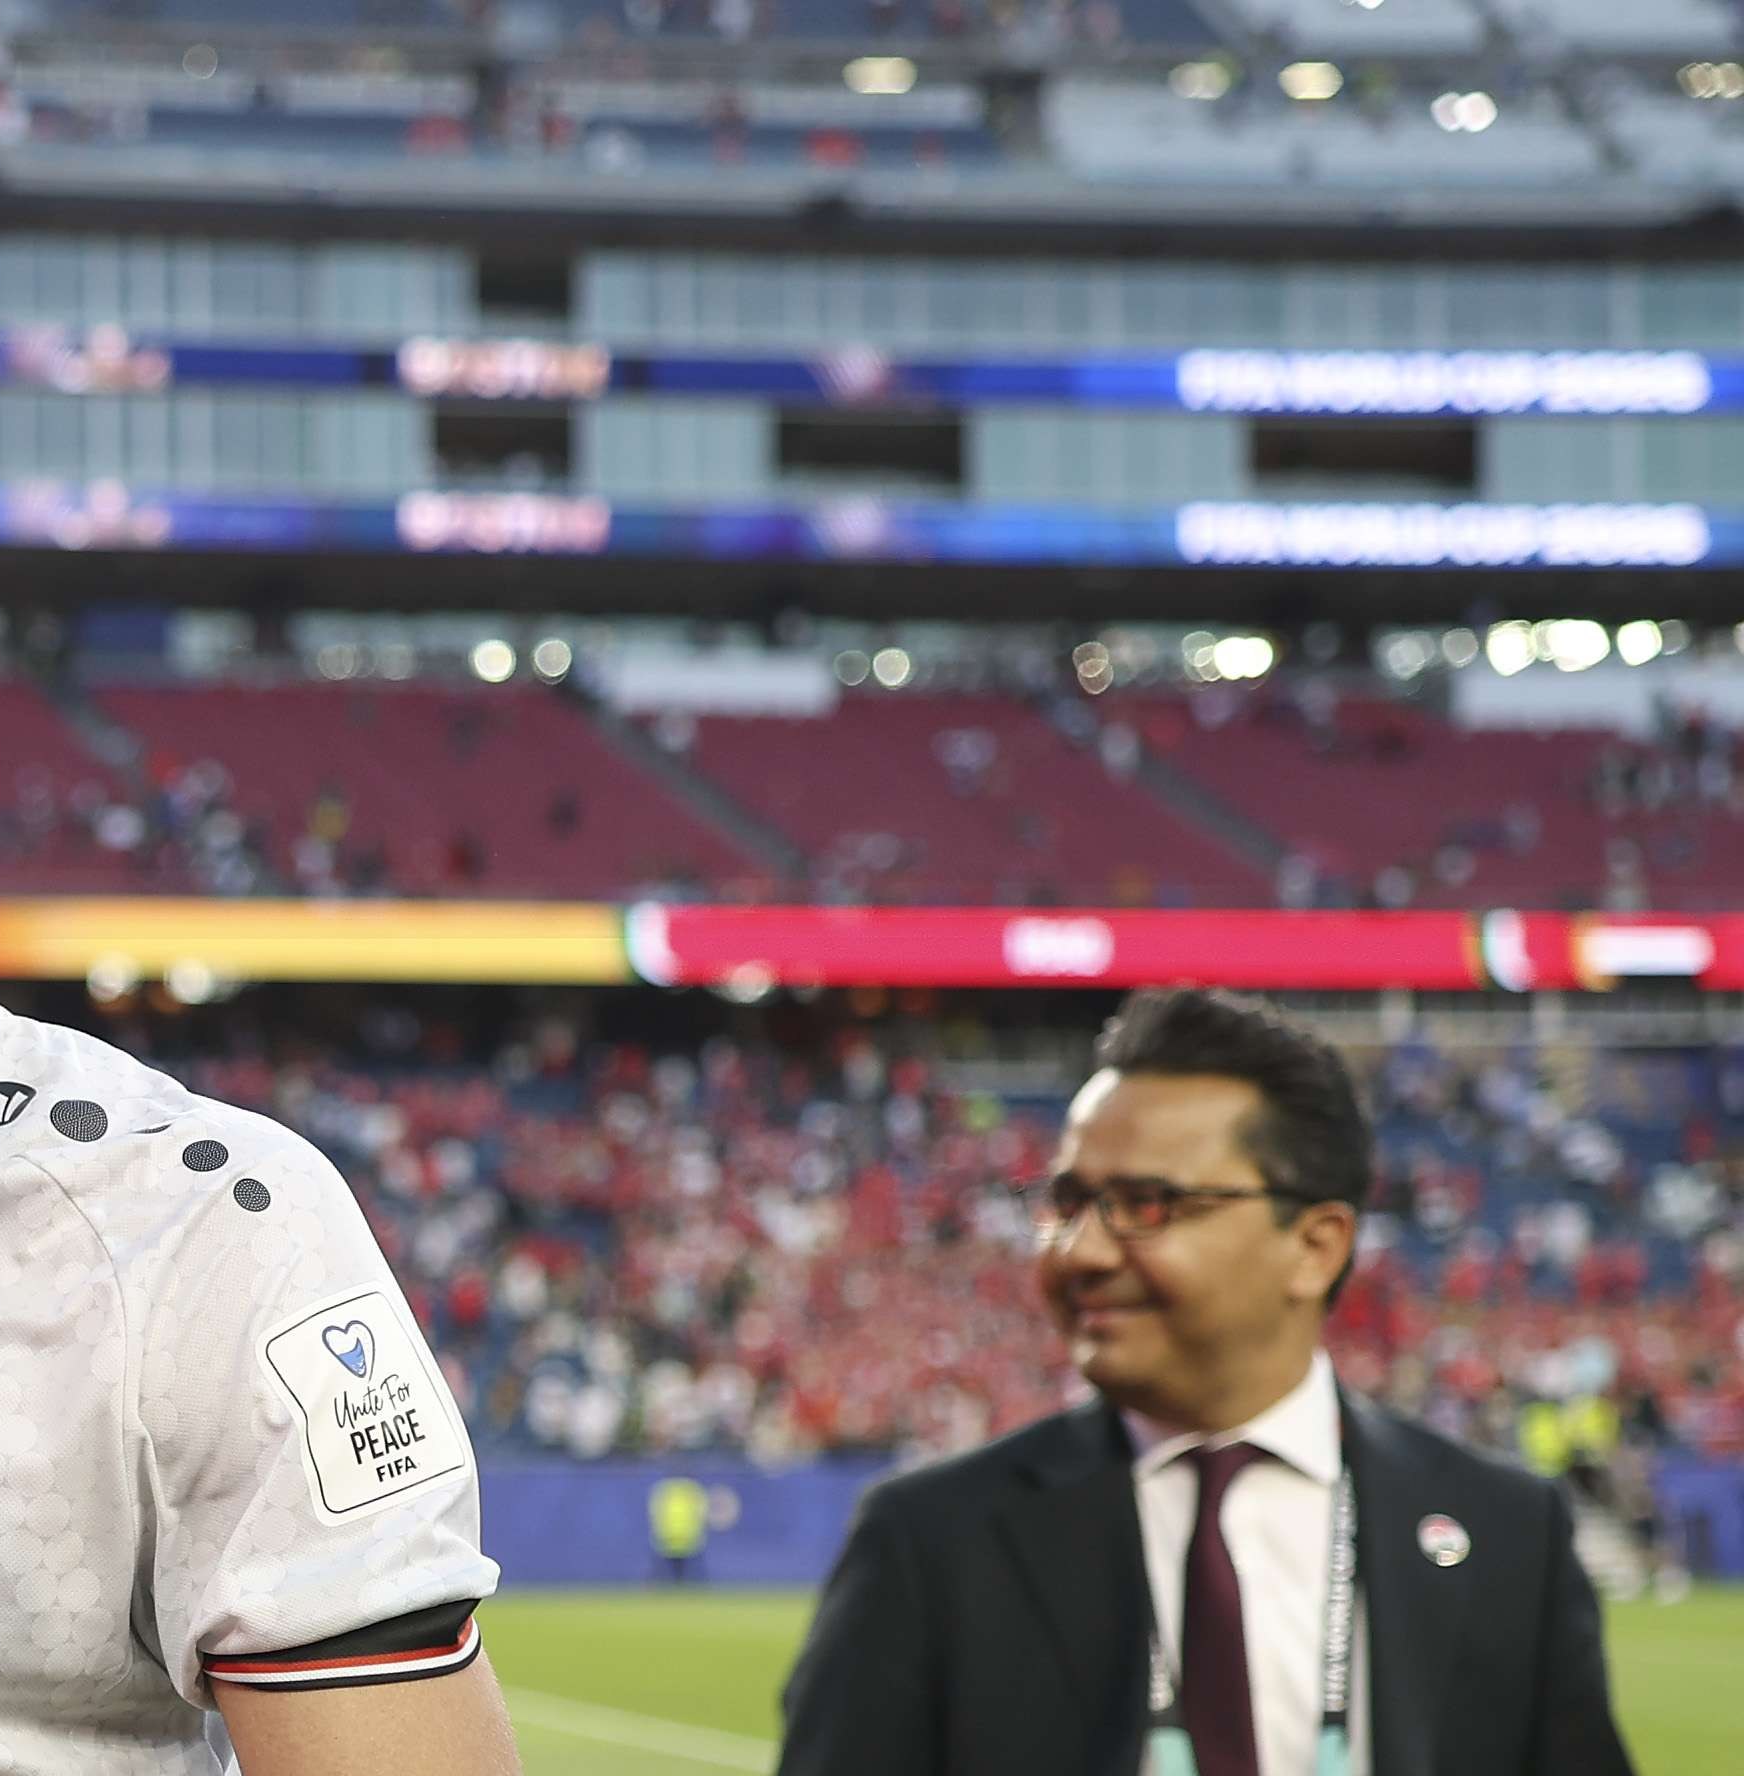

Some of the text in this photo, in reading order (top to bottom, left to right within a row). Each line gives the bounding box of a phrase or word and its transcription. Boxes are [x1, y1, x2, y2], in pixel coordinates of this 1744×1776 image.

[334, 1373, 410, 1429] Unite For
[350, 1408, 426, 1465] PEACE
[376, 1455, 417, 1483] FIFA
